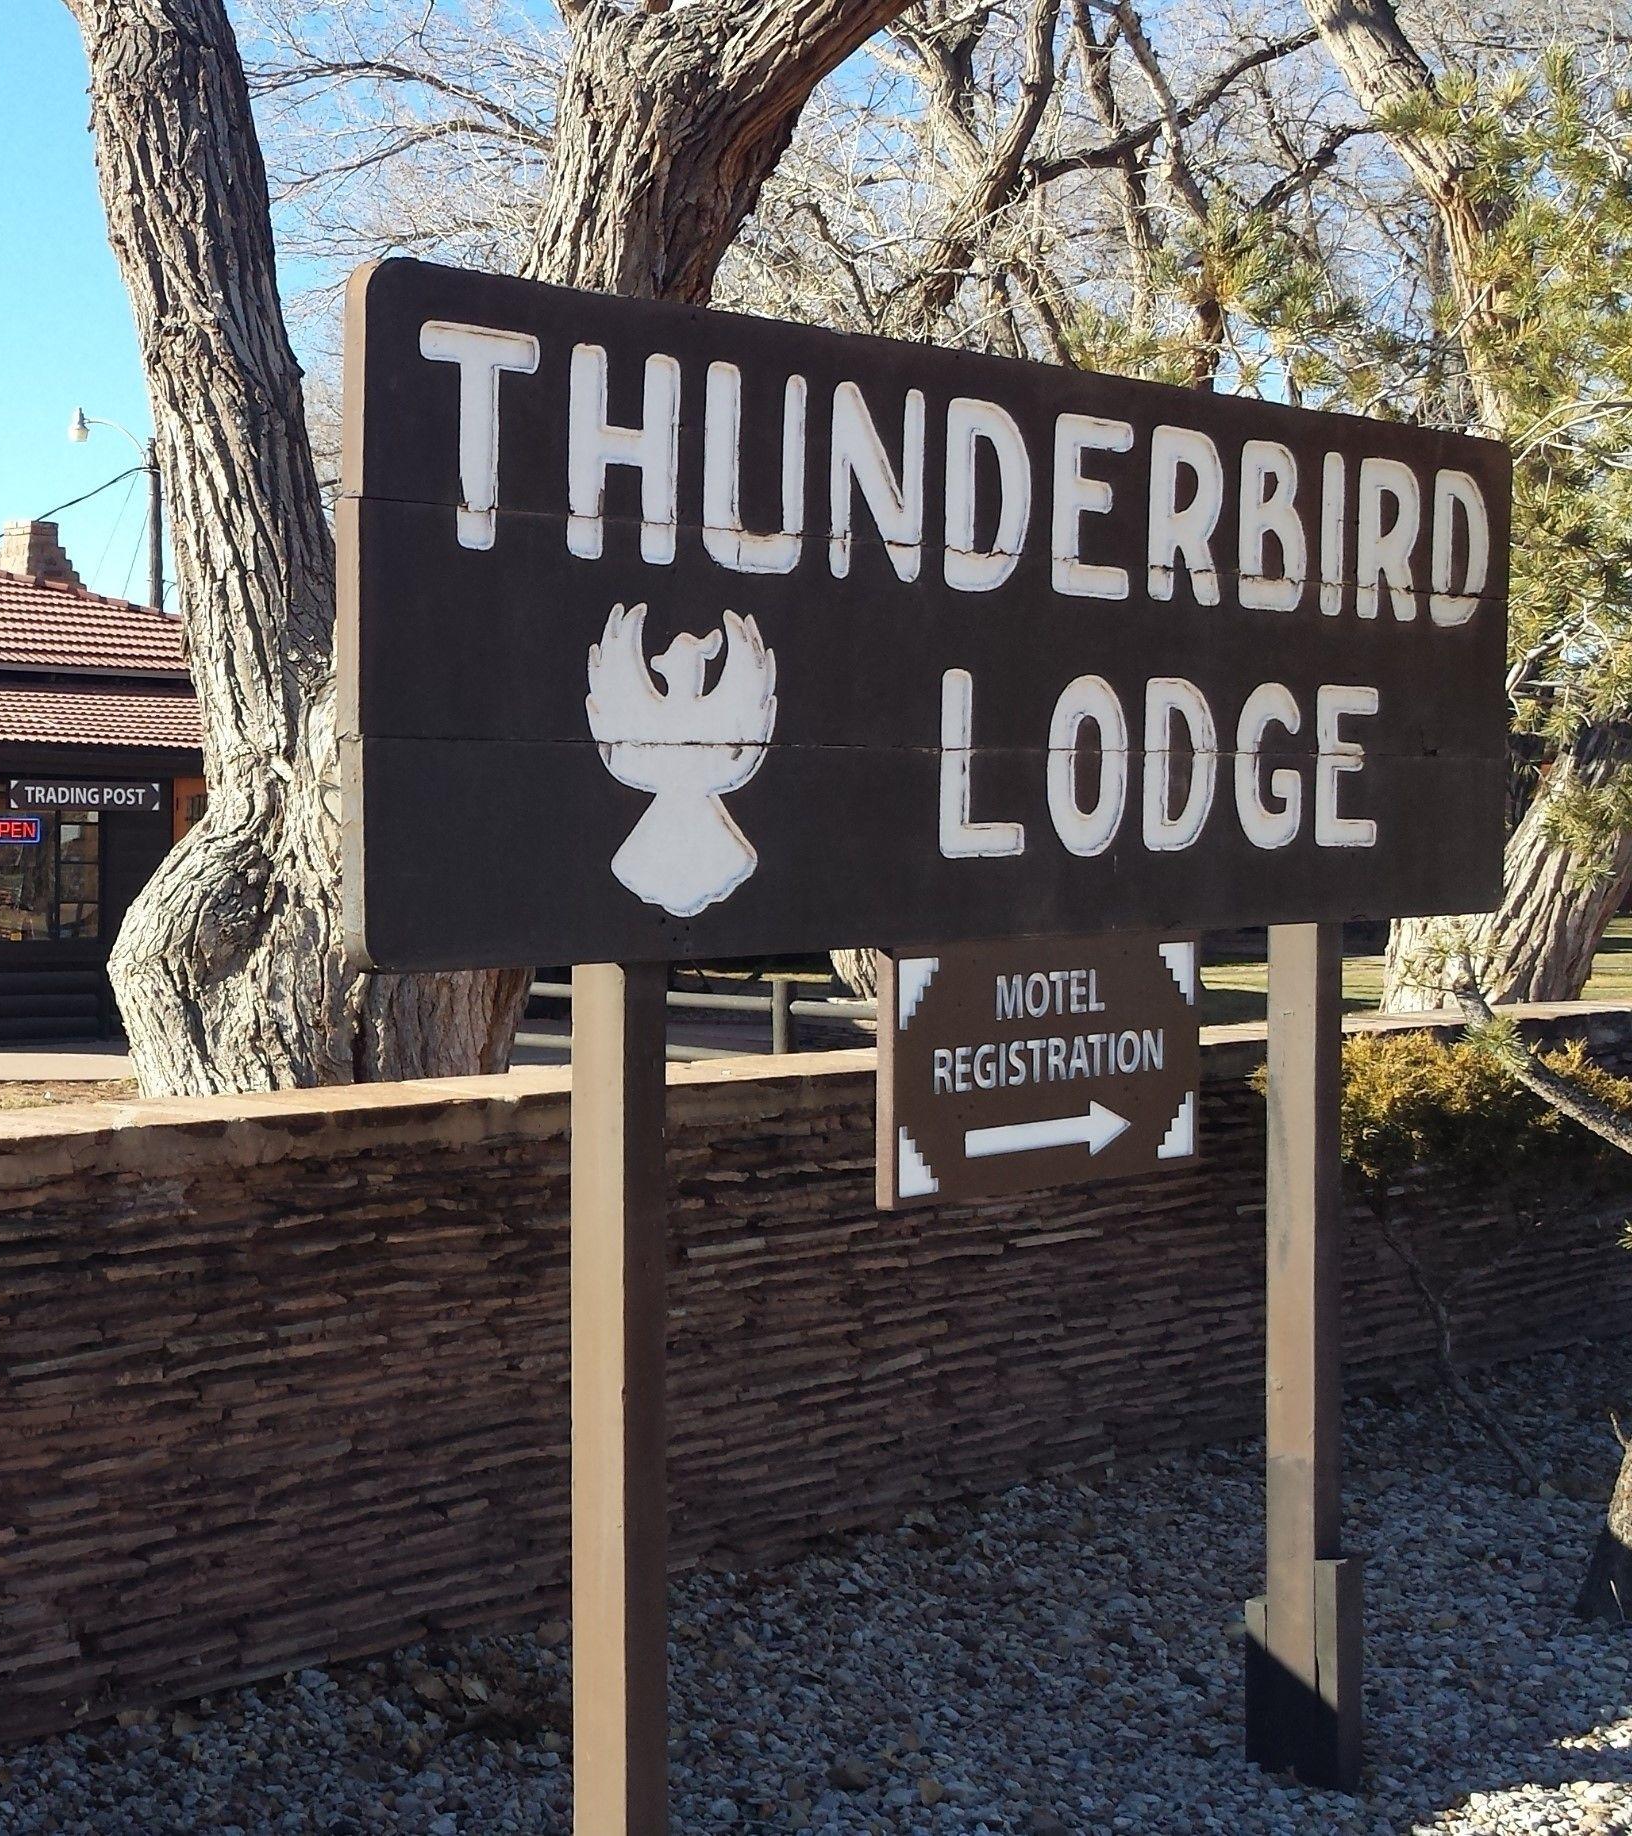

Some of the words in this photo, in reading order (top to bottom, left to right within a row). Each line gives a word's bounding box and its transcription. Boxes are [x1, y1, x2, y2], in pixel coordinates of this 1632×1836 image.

[419, 319, 1490, 627] THUNDERBIRD
[24, 786, 100, 804] TRADING
[103, 788, 146, 805] POST
[939, 668, 1379, 858] LODGE
[995, 968, 1106, 1021] MOTEL
[933, 1028, 1164, 1095] REGISTRATION
